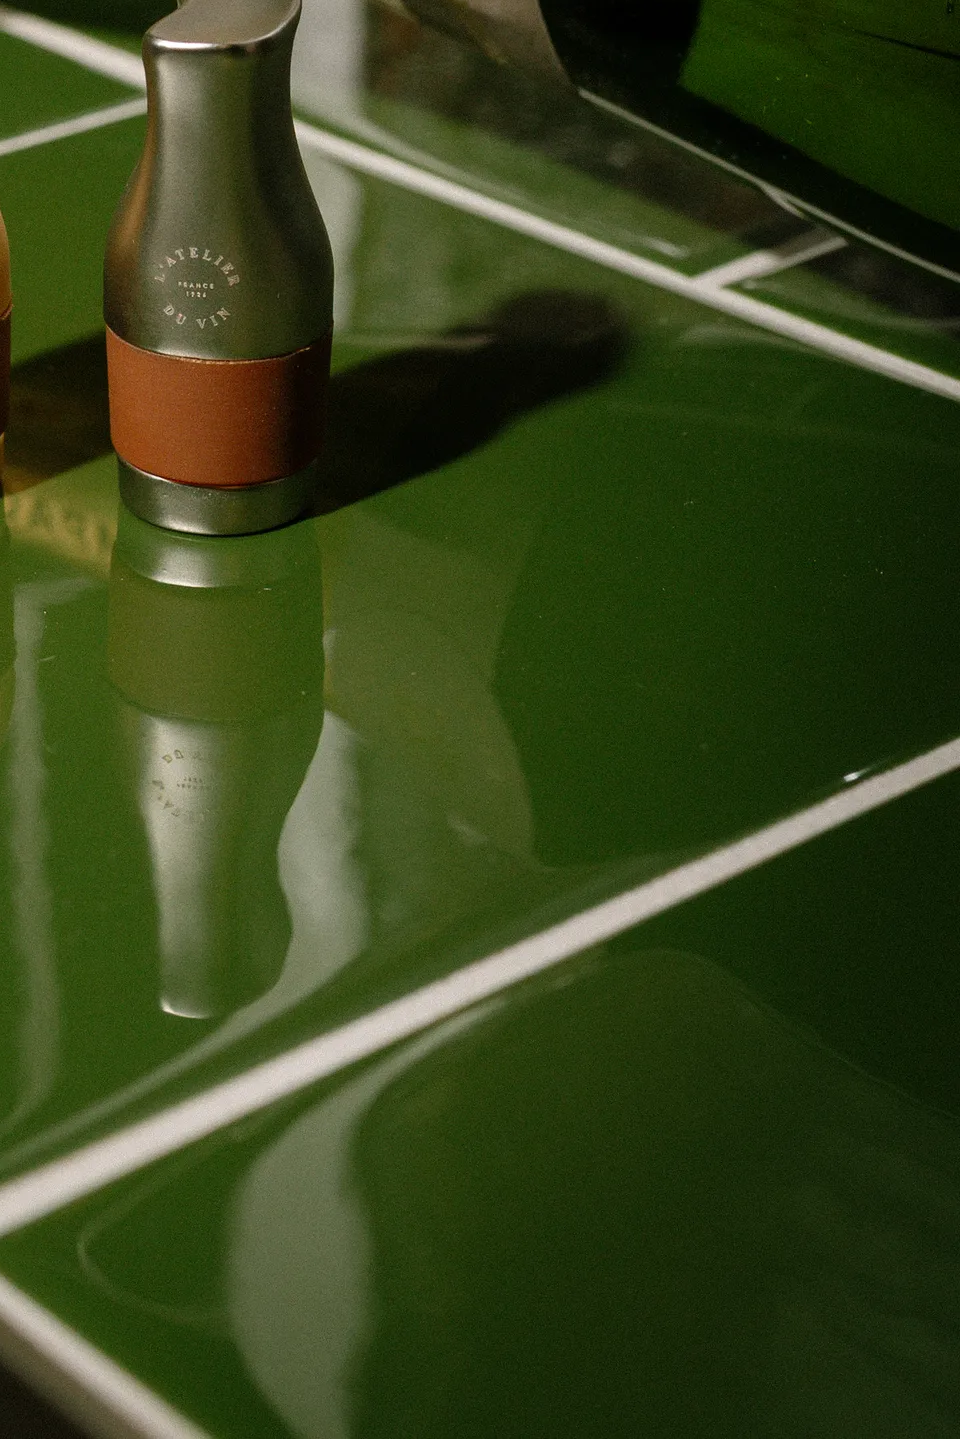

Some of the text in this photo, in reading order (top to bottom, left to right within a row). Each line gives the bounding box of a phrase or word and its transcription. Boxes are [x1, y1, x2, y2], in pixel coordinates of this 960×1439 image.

[154, 246, 240, 287] L'ATELIER
[177, 281, 215, 290] FRANCE
[163, 303, 231, 329] DU VIN
